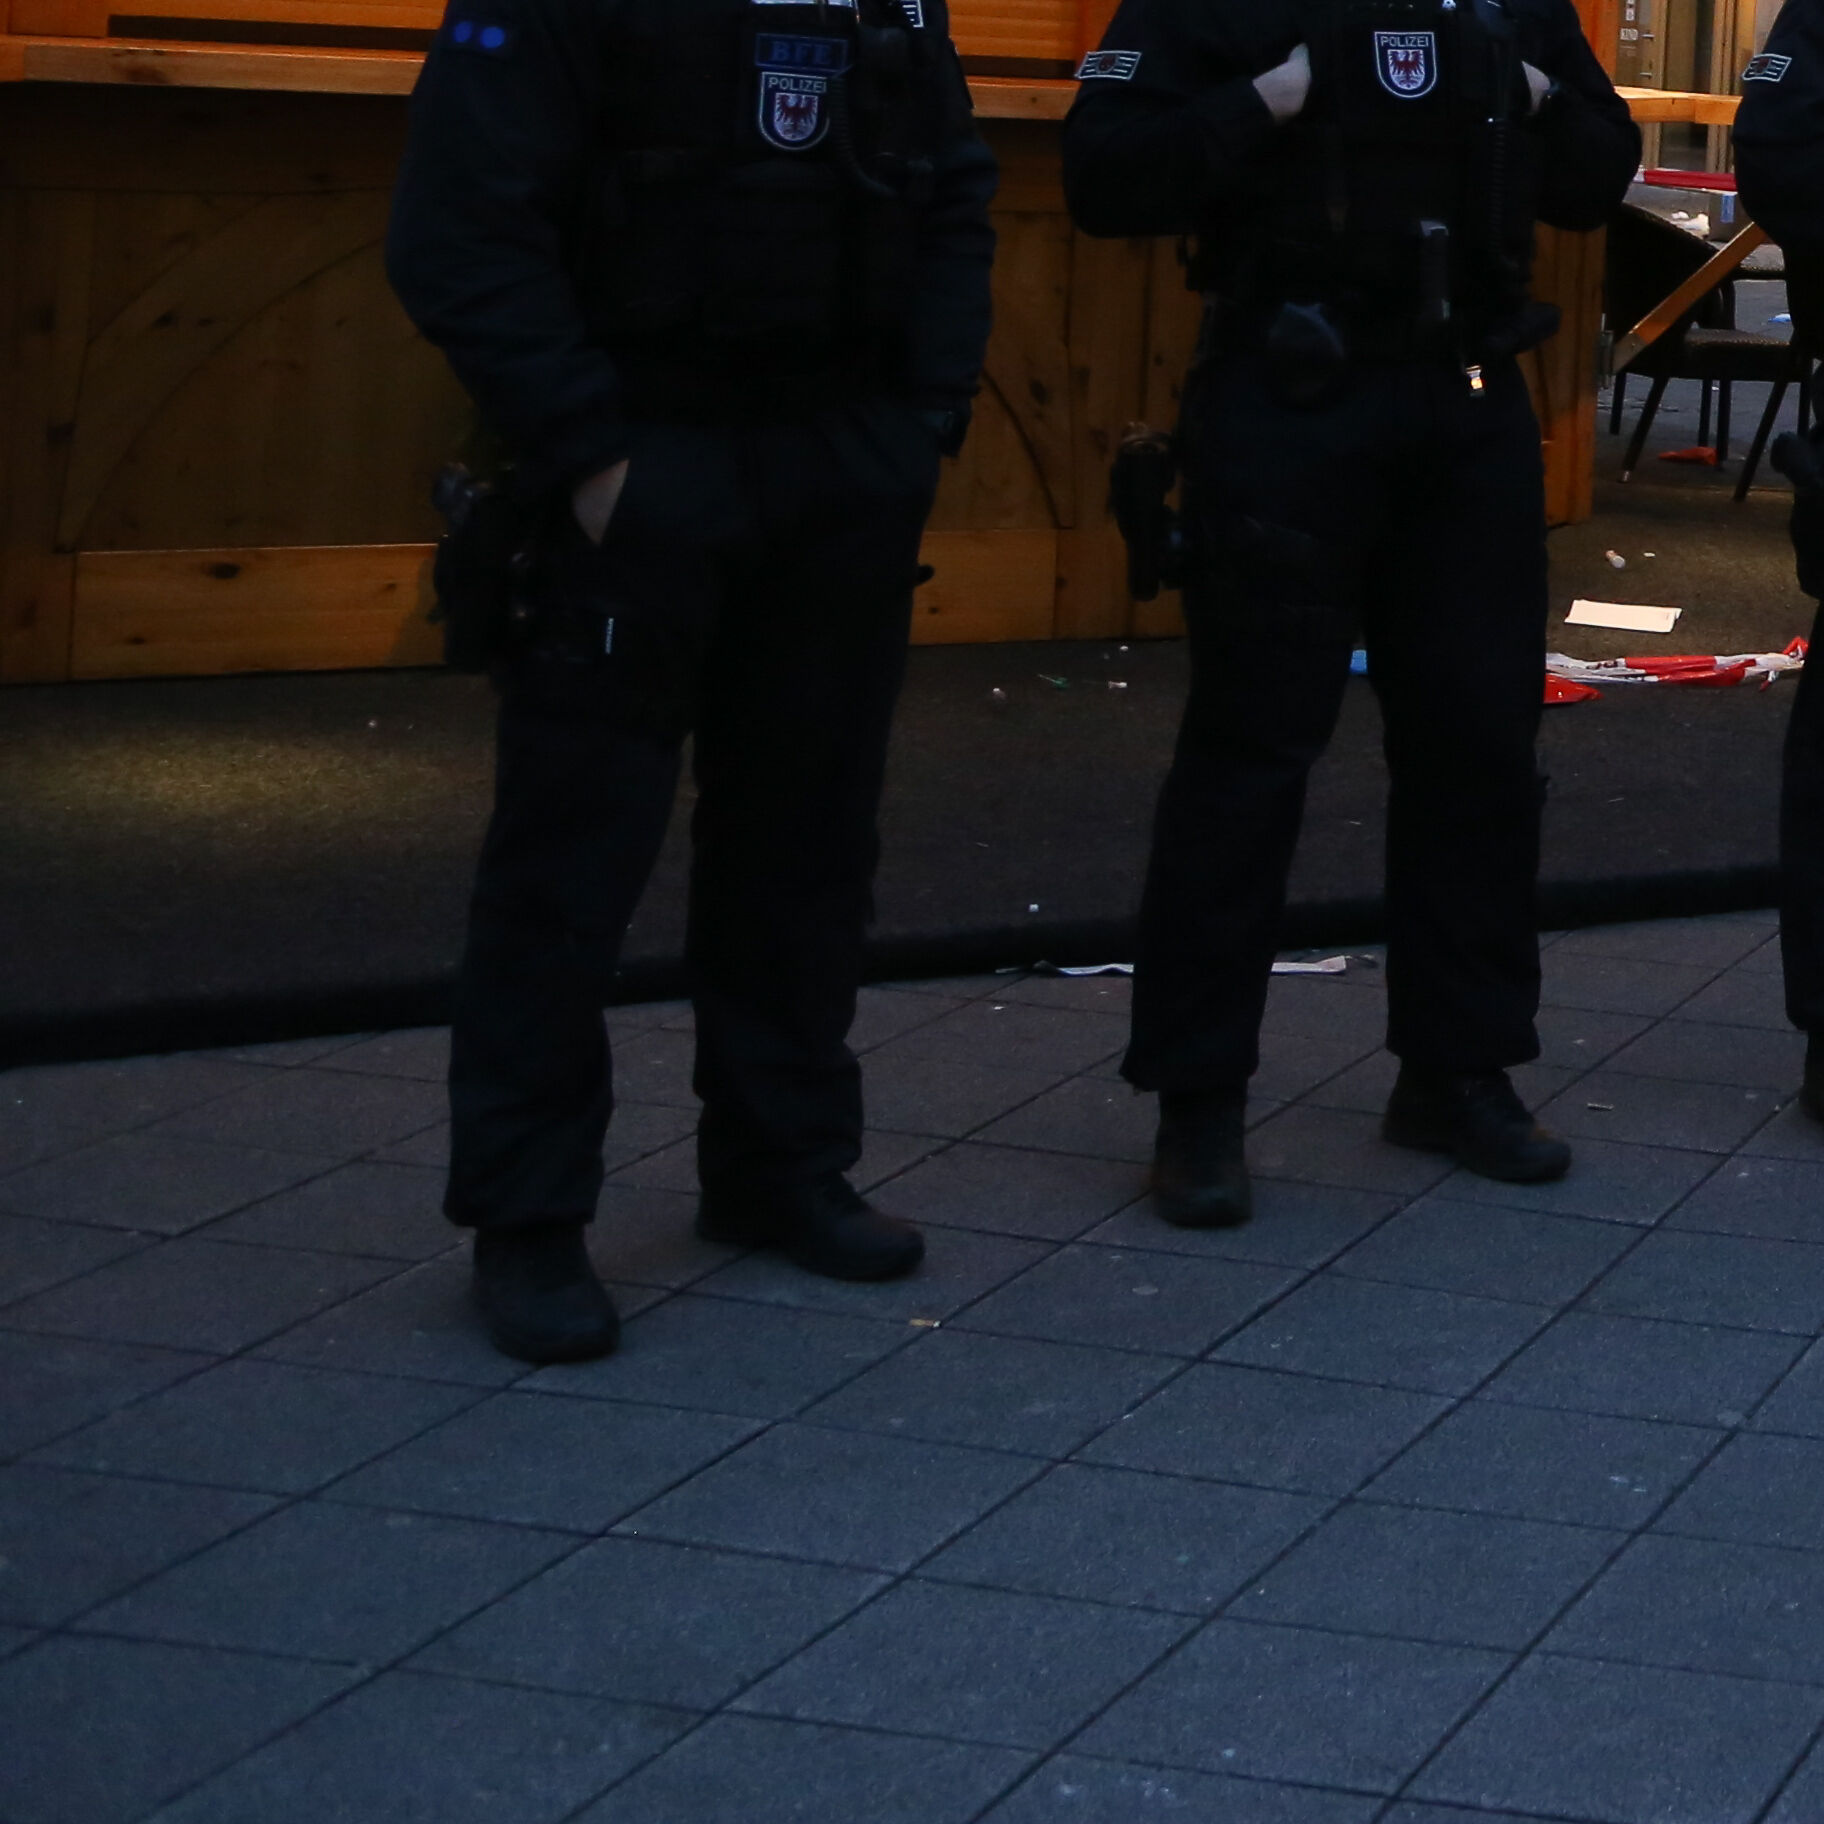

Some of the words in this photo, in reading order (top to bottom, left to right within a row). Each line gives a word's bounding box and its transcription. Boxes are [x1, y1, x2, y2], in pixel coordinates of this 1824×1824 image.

[1380, 36, 1429, 48] POLIZEI
[771, 41, 833, 63] BFE
[768, 76, 828, 94] POLIZEI
